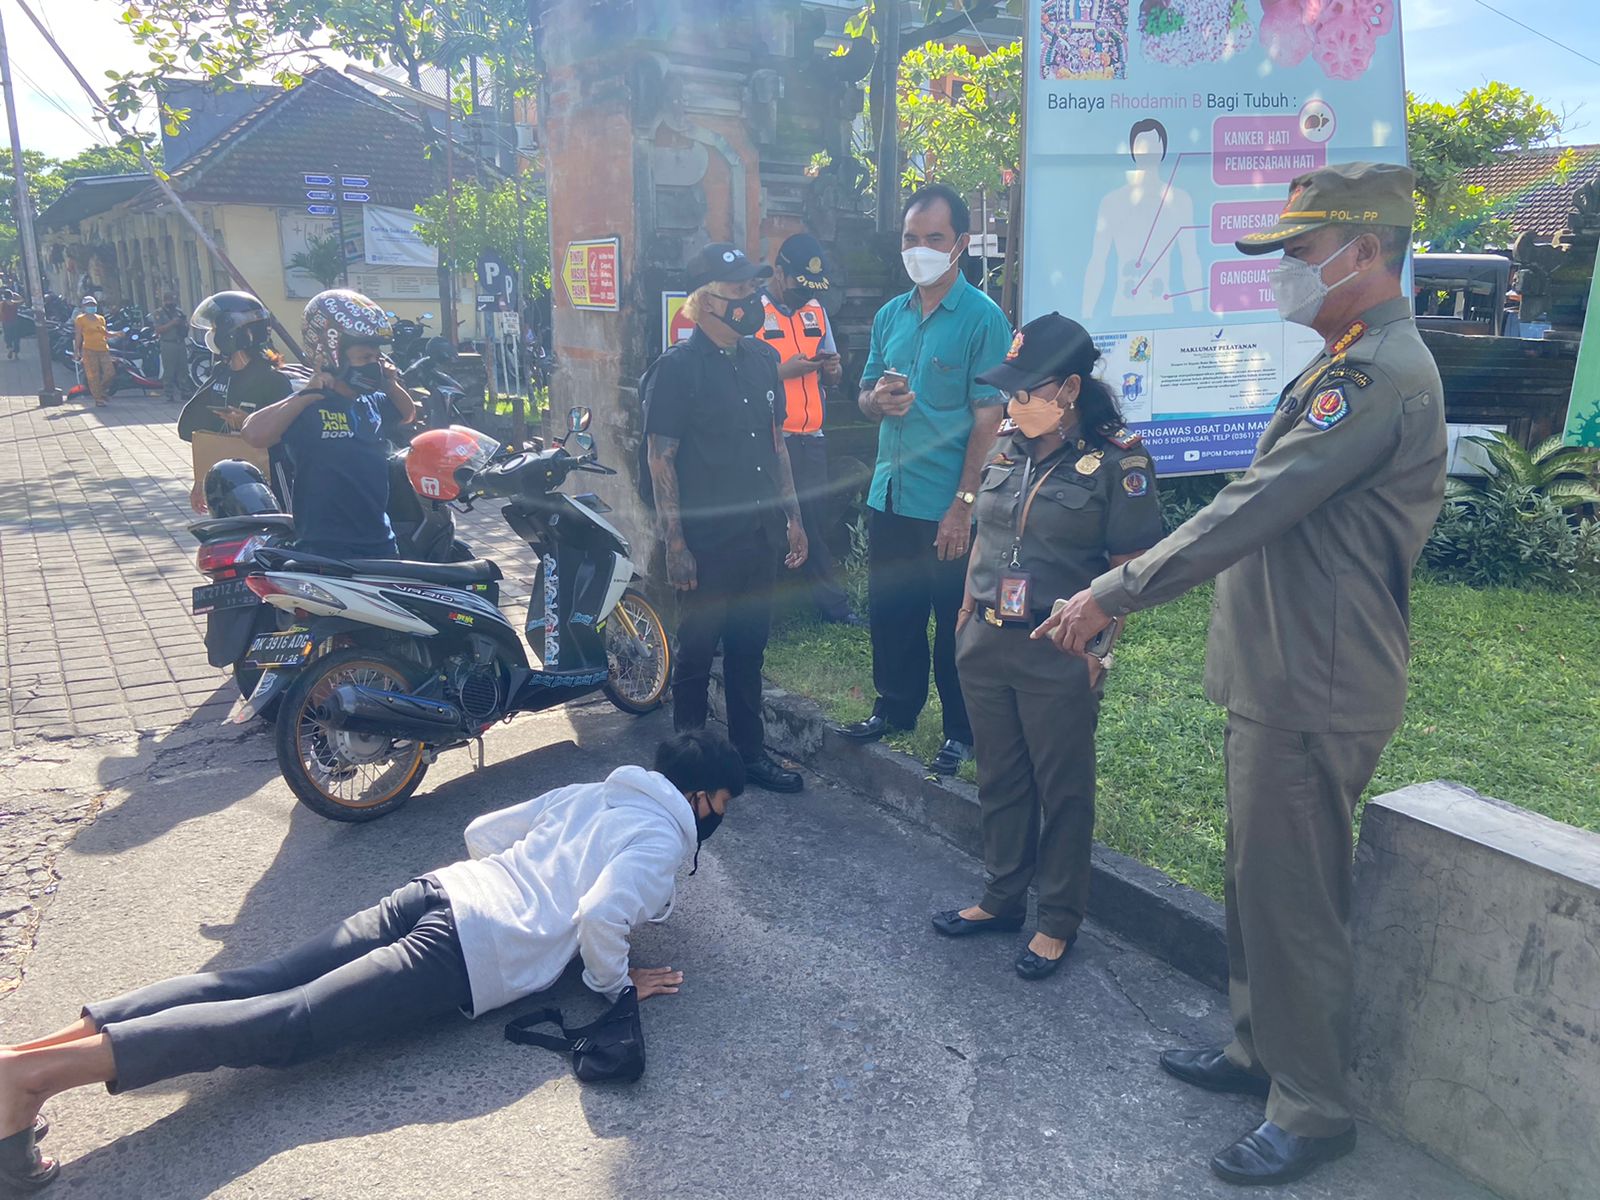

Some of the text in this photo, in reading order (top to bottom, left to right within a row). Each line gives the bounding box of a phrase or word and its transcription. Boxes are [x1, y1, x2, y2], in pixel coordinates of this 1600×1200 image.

[1048, 93, 1105, 113] Bahaya
[1110, 92, 1187, 109] Rhodamin
[1192, 92, 1202, 108] B
[1207, 92, 1239, 112] Bagi
[1243, 92, 1289, 108] Tubuh
[1224, 130, 1290, 146] KANKER HATI
[1225, 154, 1315, 171] PEMBESARAN HATI
[1220, 214, 1280, 230] PEMBESARA
[484, 262, 500, 285] P
[1218, 343, 1257, 351] PELAYANAN
[1194, 424, 1221, 434] OBAT
[1223, 422, 1245, 432] DAN
[1247, 421, 1271, 430] MAK
[321, 431, 354, 439] BODY
[1213, 433, 1230, 441] TELP
[1231, 431, 1254, 440] (0361)
[1152, 449, 1254, 462] npasar BPOM Denpasar
[251, 637, 267, 651] DK
